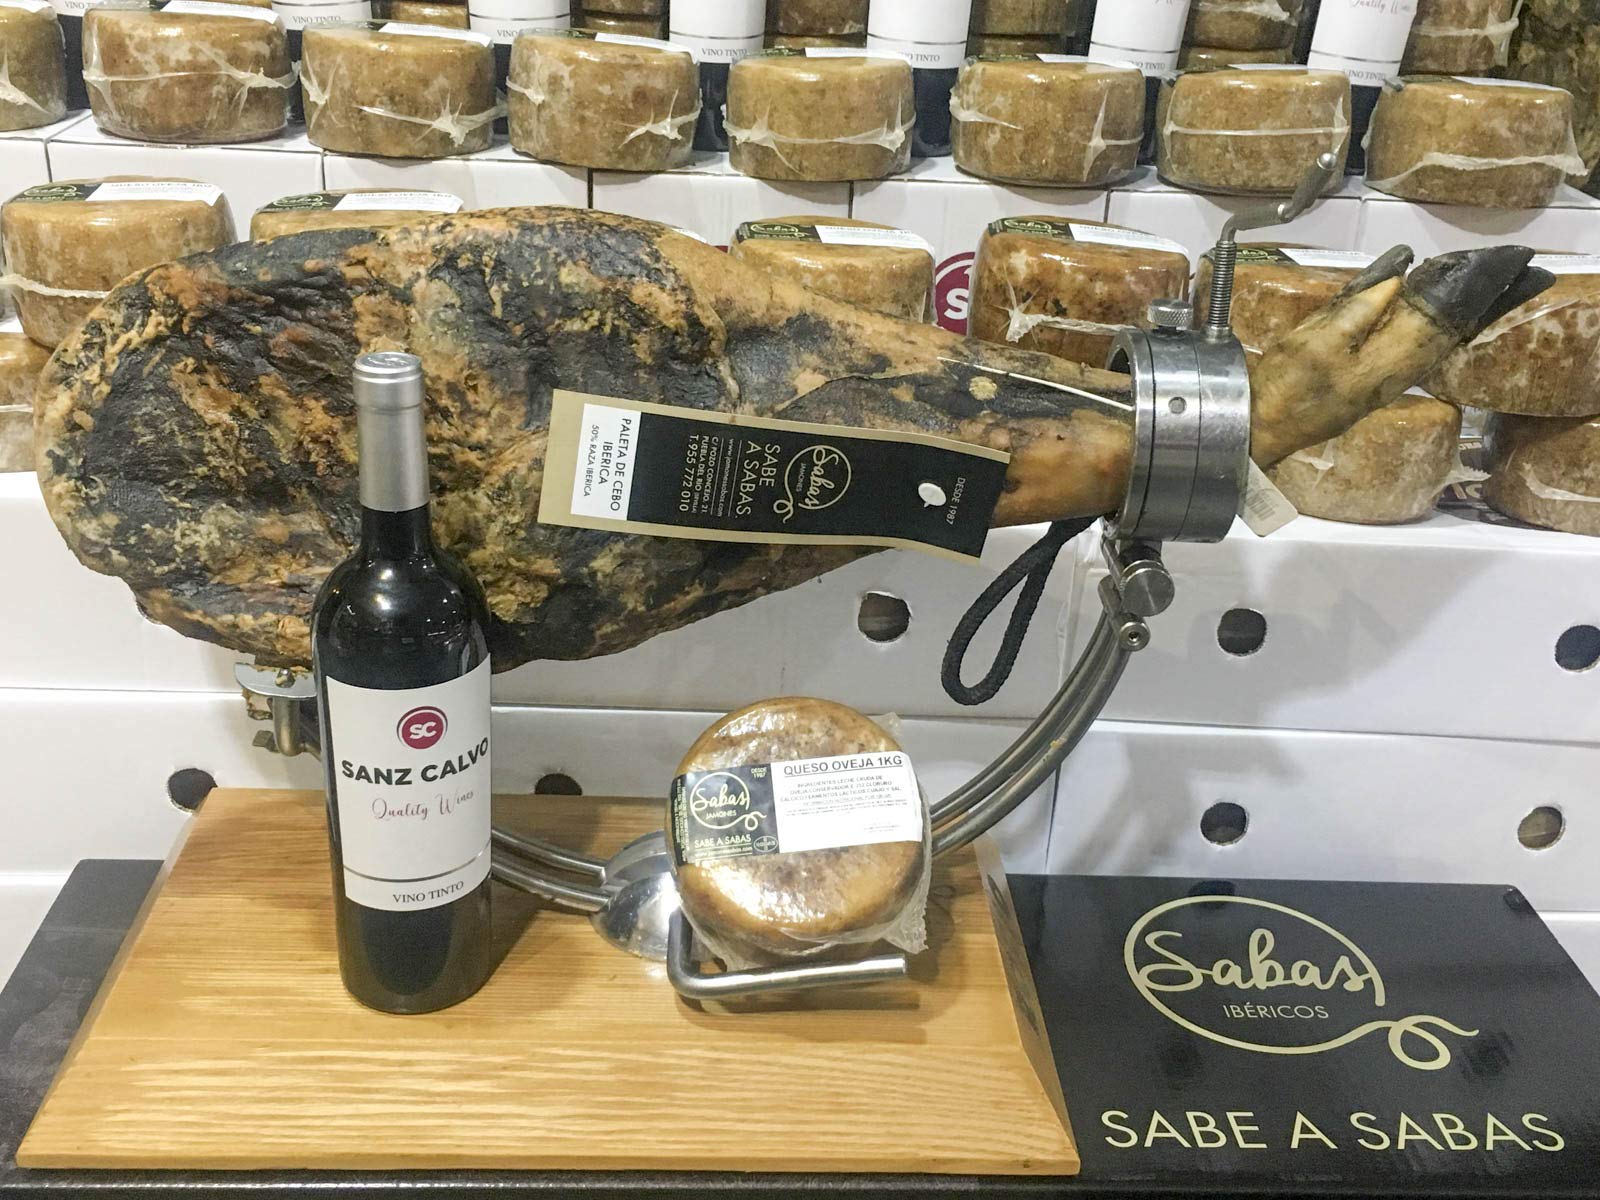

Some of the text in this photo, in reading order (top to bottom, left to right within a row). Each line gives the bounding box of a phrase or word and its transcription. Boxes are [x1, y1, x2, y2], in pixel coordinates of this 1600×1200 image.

[292, 15, 313, 23] VINO
[701, 47, 724, 57] VINO
[916, 53, 941, 61] TINTO
[583, 424, 599, 497] 50% RAZA IBERICA
[700, 435, 710, 462] PUEBLA
[708, 446, 718, 467] POZO
[598, 441, 614, 485] IBERICA
[610, 418, 632, 511] PALETA DE CEBO
[697, 463, 706, 477] DEL
[759, 443, 780, 487] SABE
[682, 467, 695, 488] 772
[735, 440, 762, 519] A SABAS.
[796, 462, 807, 492] JAMONES
[804, 447, 839, 508] Sabas
[679, 490, 691, 512] 010
[946, 476, 966, 525] DESDE 1987
[409, 721, 438, 740] SC
[341, 737, 489, 786] SANZ CALVO
[784, 755, 903, 775] QUESO OVEJA 1KG
[370, 787, 475, 822] Quality Wines
[693, 784, 748, 811] Sabas
[705, 810, 737, 820] JAMONES
[694, 837, 715, 848] SABE
[716, 837, 724, 846] A
[725, 834, 752, 844] SABAS
[392, 880, 465, 904] VINO TINTO
[1138, 928, 1374, 992] Sabas
[1223, 1001, 1329, 1020] IBÉRICOS
[1100, 1109, 1565, 1152] SABE A SABAS
